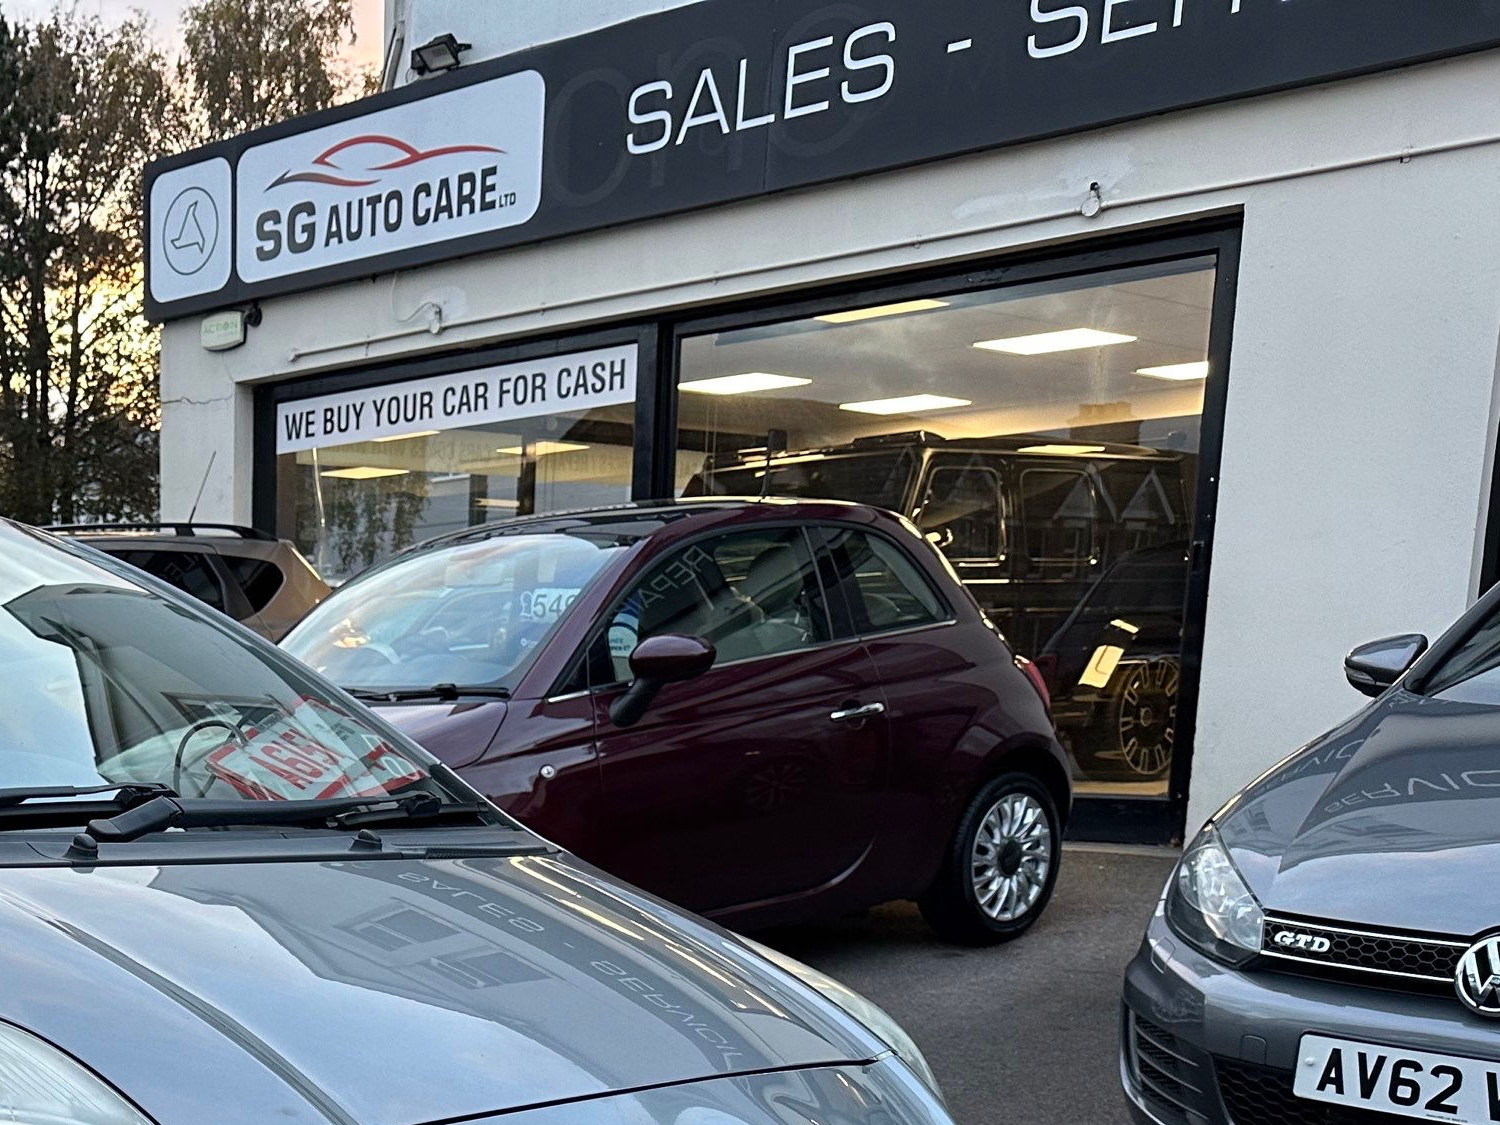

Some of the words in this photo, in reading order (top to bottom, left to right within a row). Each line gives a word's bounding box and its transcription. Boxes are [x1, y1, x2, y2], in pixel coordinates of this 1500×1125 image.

[626, 21, 896, 155] SALES
[255, 200, 317, 262] SG
[324, 189, 402, 248] AUTO
[412, 165, 498, 227] CARE
[498, 191, 517, 210] LTD
[285, 409, 316, 441] WE
[323, 401, 366, 435] BUY
[372, 390, 434, 428] YOUR
[443, 381, 489, 417] CAR
[498, 372, 547, 409] FOR
[556, 358, 626, 399] CASH
[1273, 930, 1331, 953] GTD
[1315, 1047, 1463, 1115] AV62
